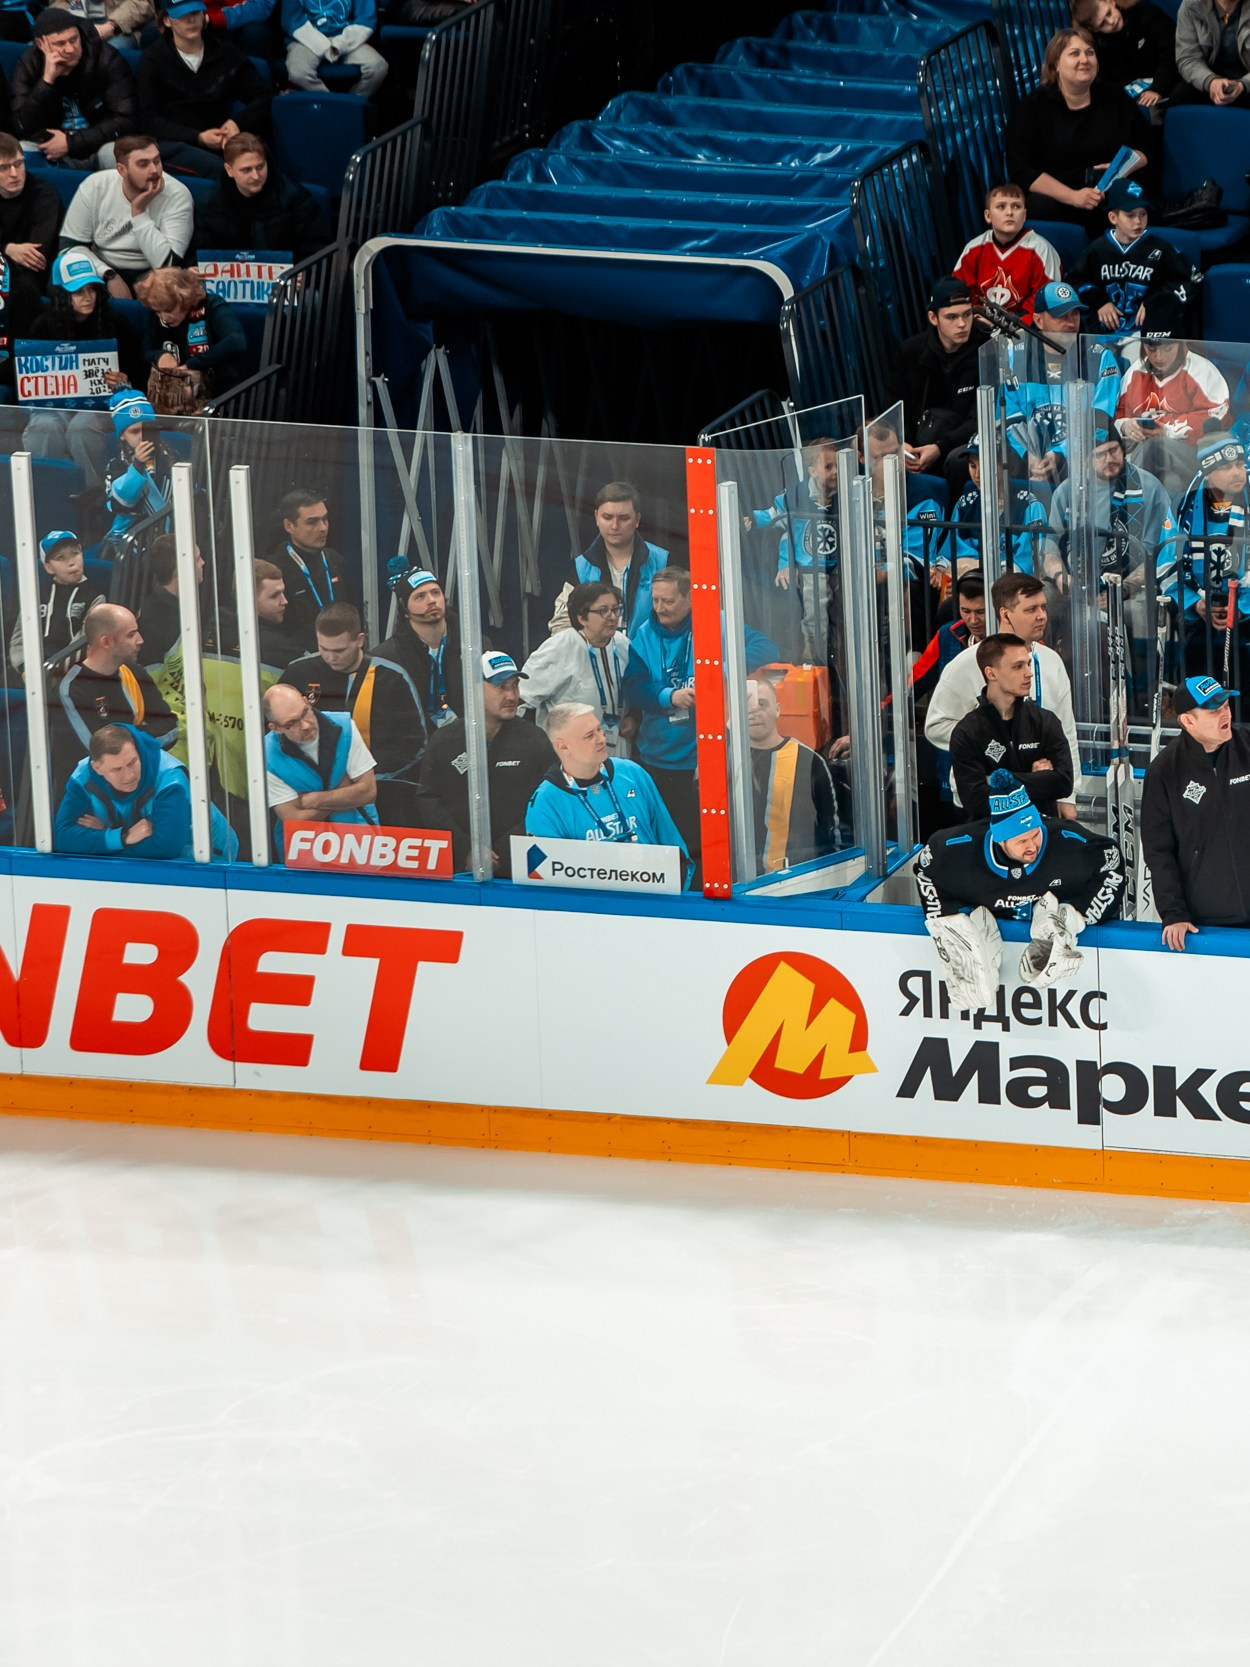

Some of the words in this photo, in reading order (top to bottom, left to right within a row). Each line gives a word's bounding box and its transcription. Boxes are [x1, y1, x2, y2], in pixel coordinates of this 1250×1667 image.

[17, 354, 79, 374] КОСТИН
[83, 357, 109, 366] МАТЧ
[20, 375, 79, 398] СТЕНА
[496, 760, 521, 768] FONBET
[288, 829, 449, 870] FONBET
[551, 860, 666, 884] Ростелеком
[0, 902, 464, 1073] NBET
